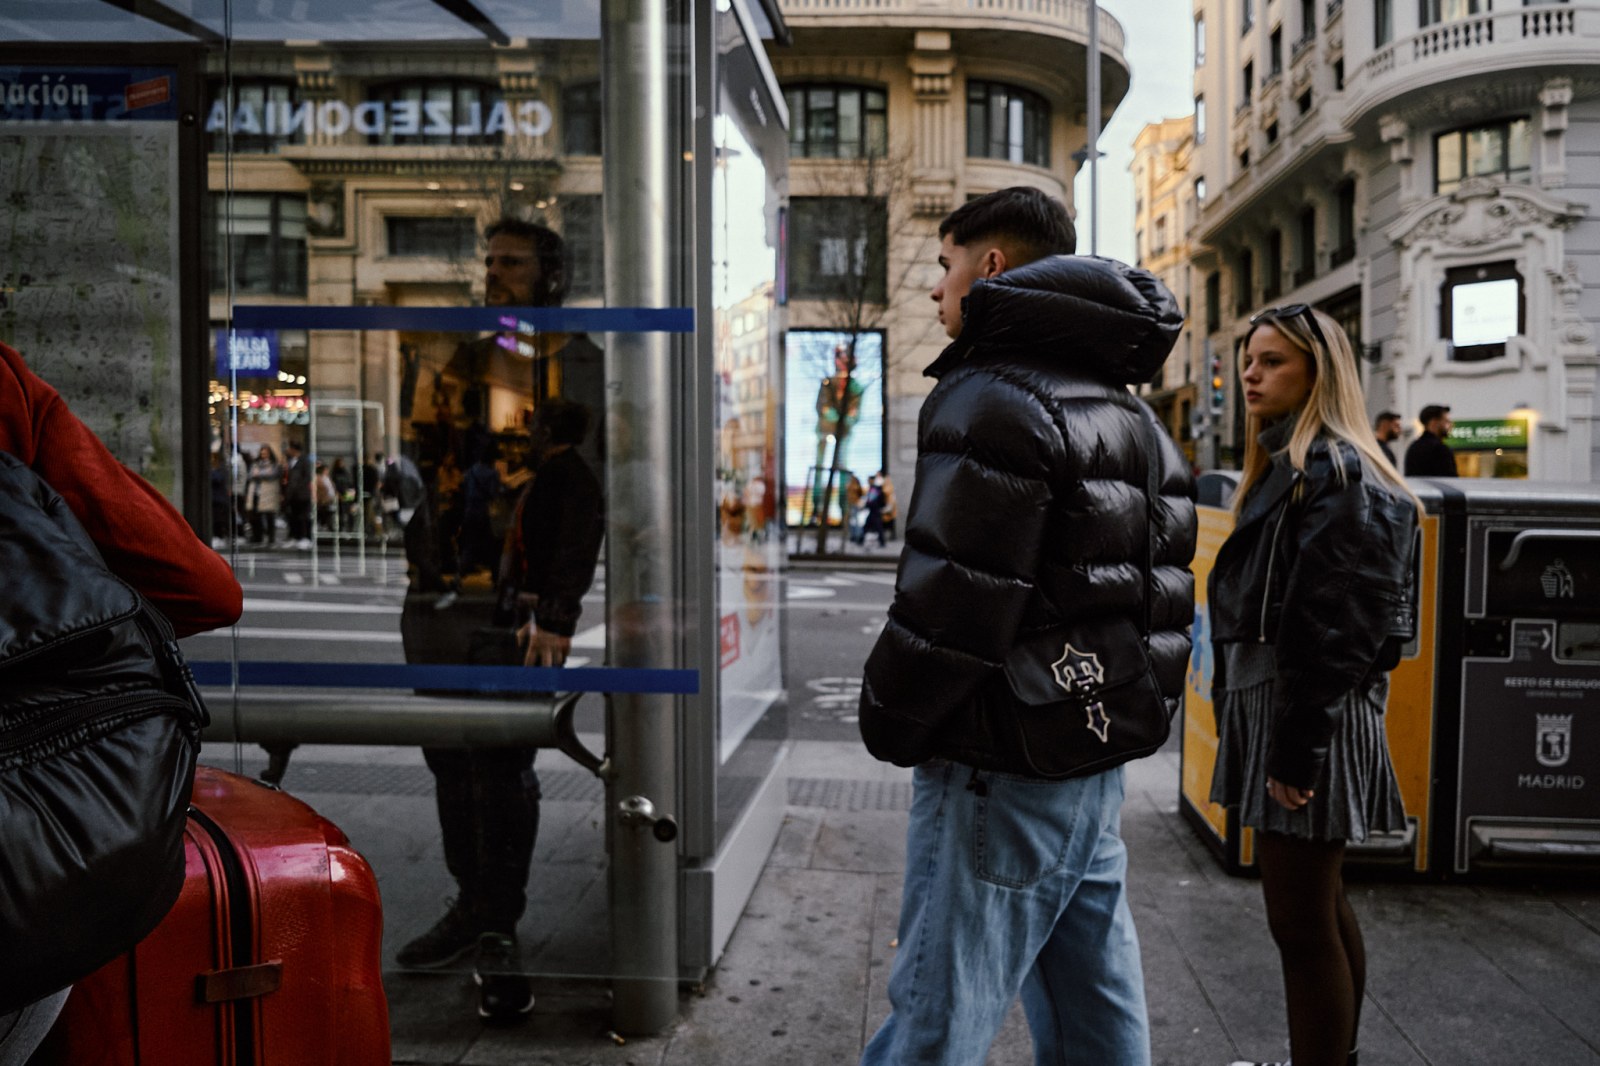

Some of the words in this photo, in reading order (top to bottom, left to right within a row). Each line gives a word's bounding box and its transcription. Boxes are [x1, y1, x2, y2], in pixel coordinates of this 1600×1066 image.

[0, 75, 89, 106] ación
[1450, 427, 1473, 438] VES
[1504, 677, 1537, 688] RESTO
[1538, 677, 1553, 688] DE
[1554, 678, 1600, 690] RESIDUO
[1518, 774, 1585, 789] MADRID
